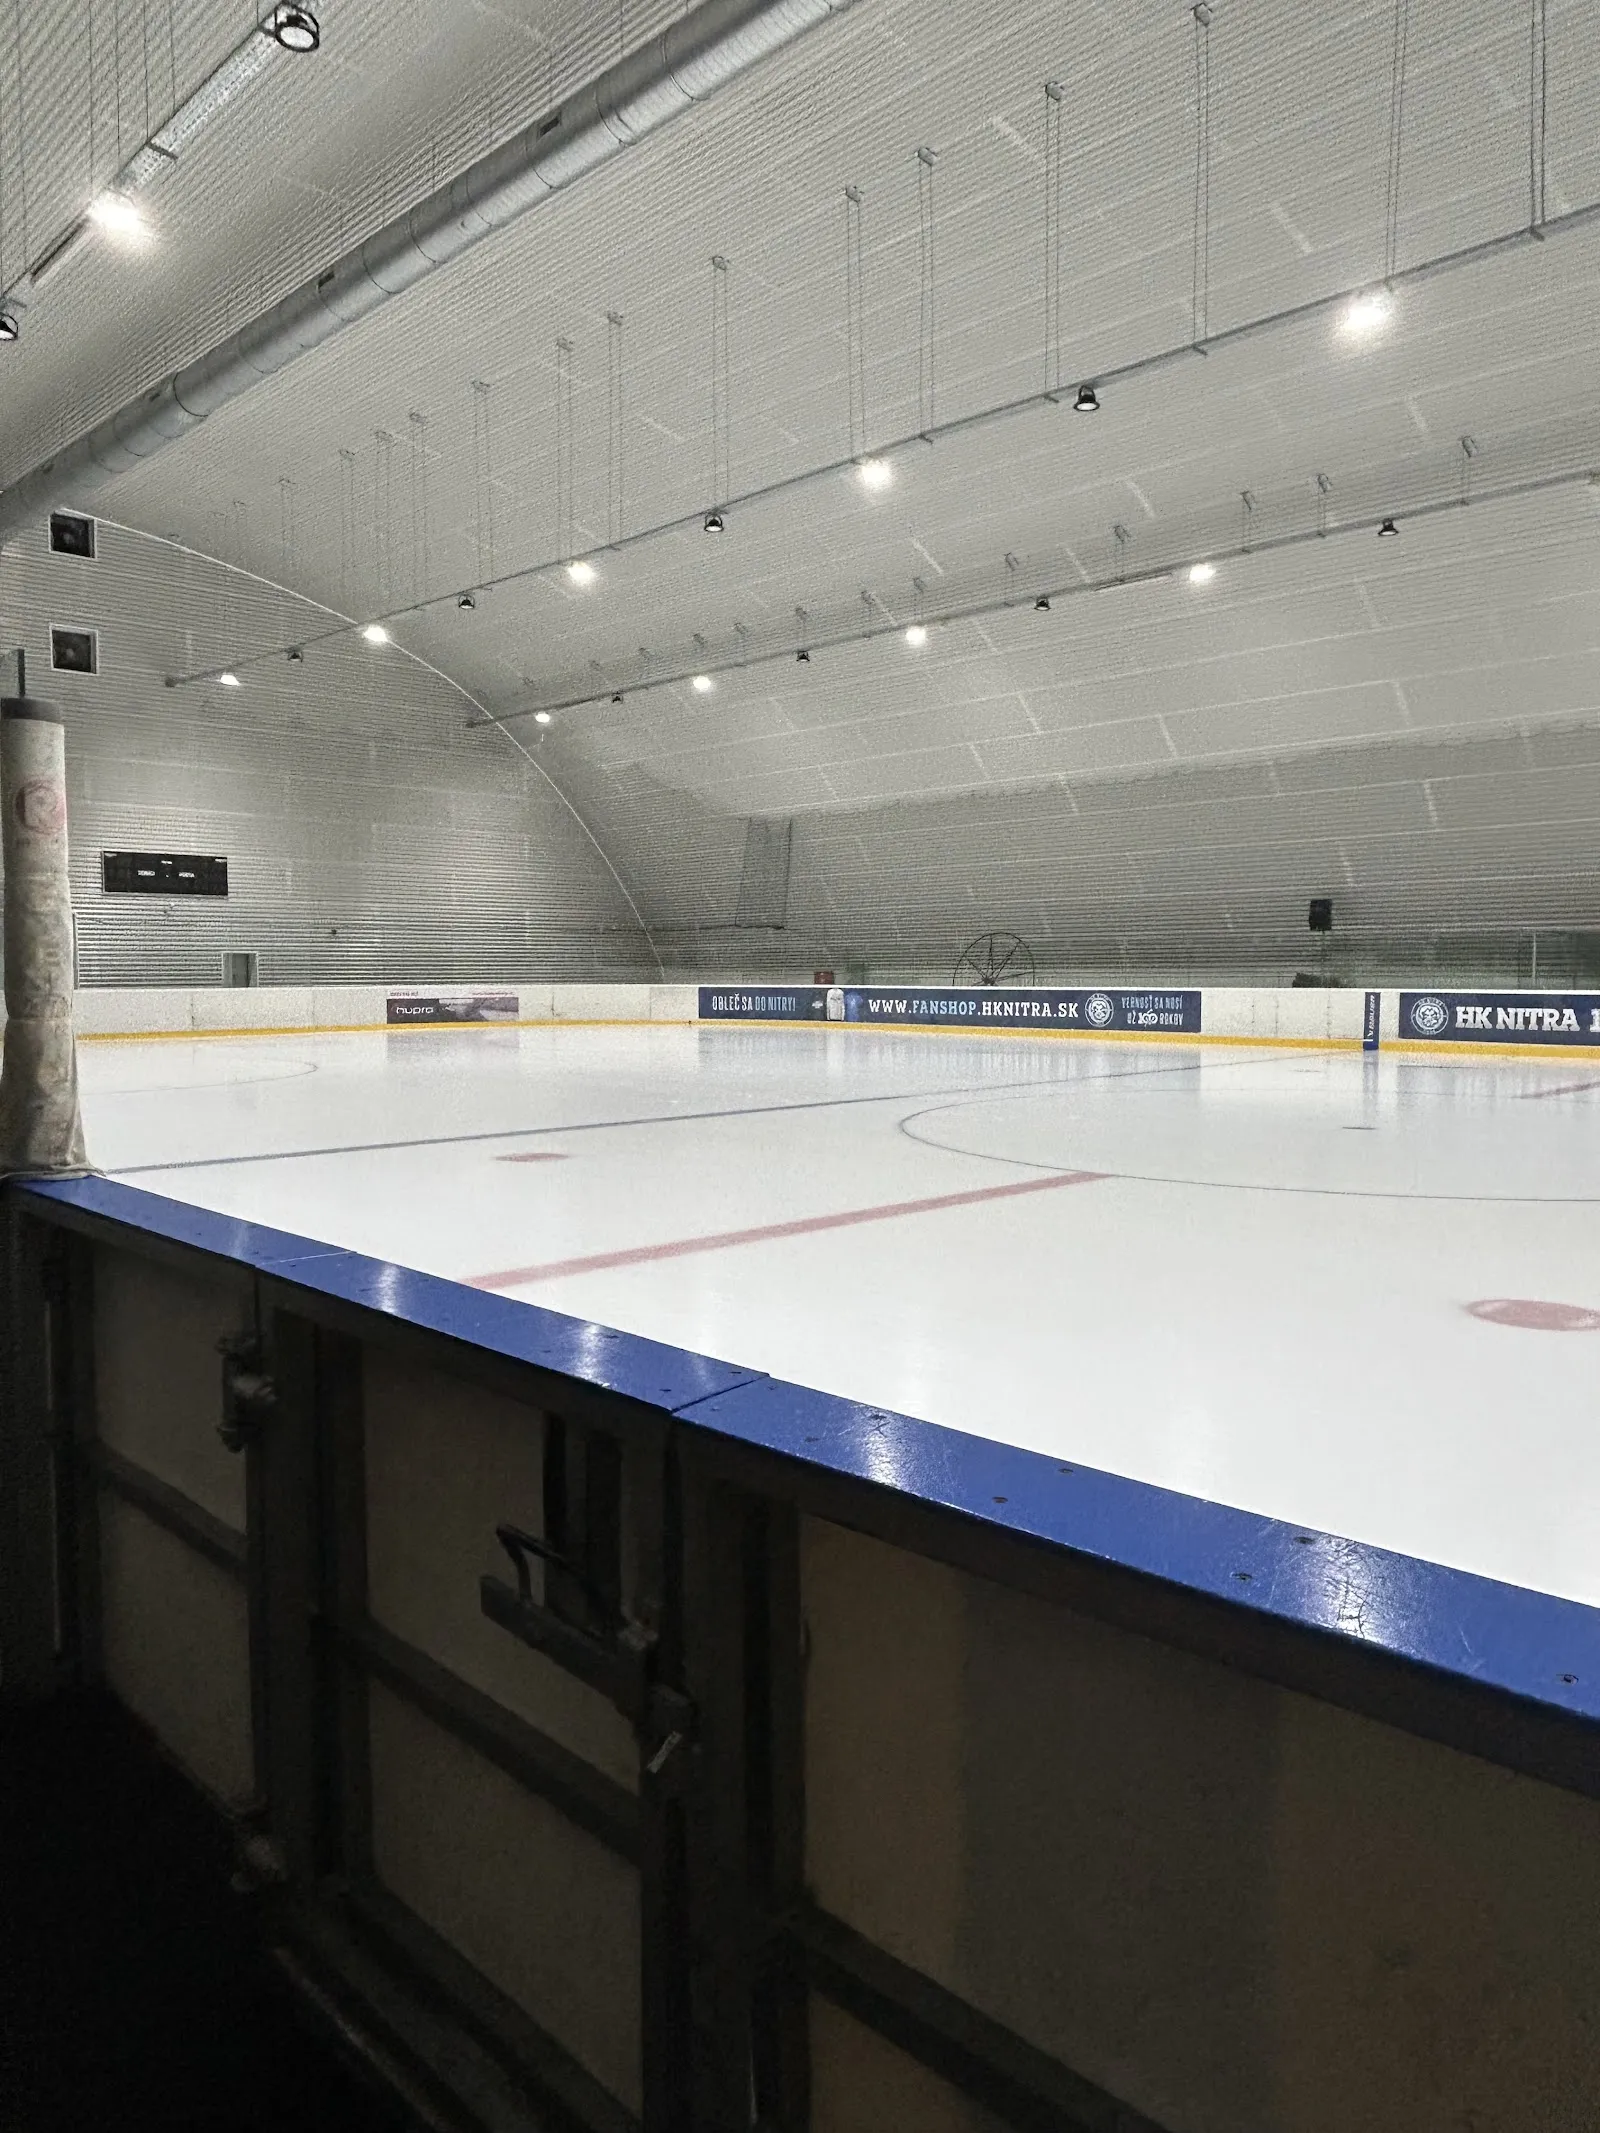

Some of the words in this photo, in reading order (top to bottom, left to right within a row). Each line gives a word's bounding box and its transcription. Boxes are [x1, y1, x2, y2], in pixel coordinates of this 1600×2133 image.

[712, 993, 740, 1011] OBLEČ
[741, 996, 753, 1011] SA
[755, 996, 766, 1012] DO
[868, 999, 1079, 1018] WWW.FANSHOP.HKNITRA.SK
[1455, 1006, 1493, 1029] HK
[1496, 1007, 1580, 1032] NITRA
